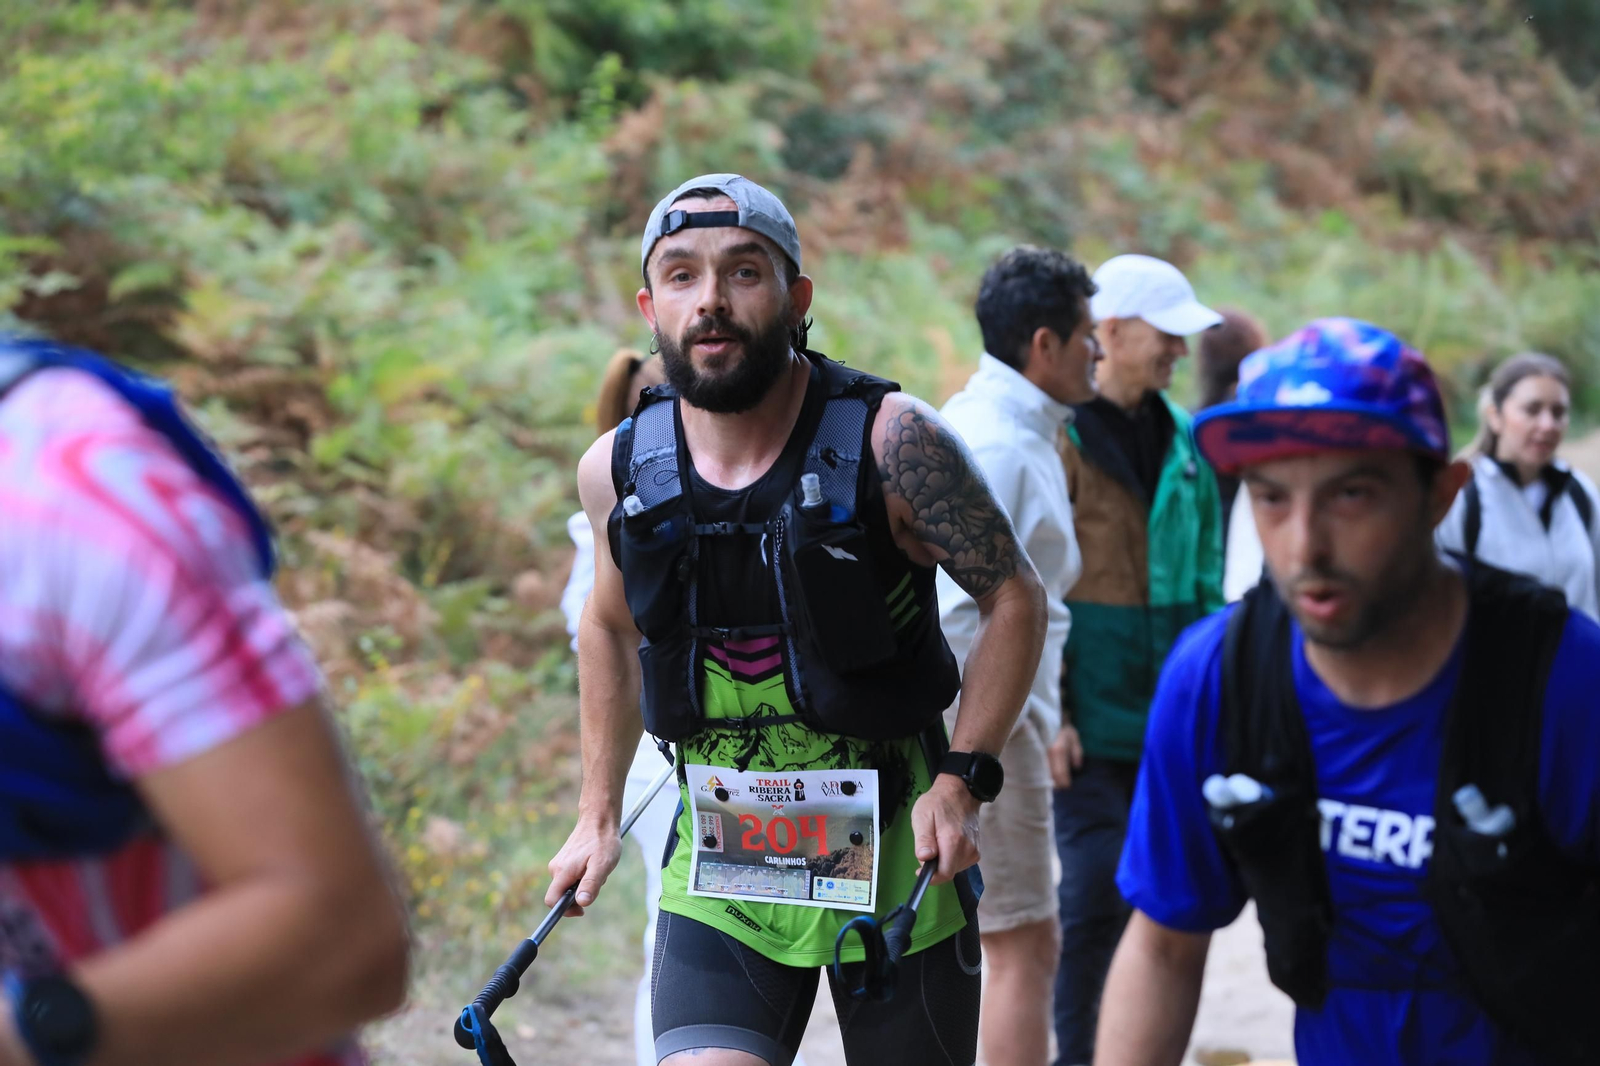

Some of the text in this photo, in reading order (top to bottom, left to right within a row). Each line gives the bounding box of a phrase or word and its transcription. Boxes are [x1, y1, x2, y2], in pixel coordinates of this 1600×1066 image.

[756, 779, 791, 787] TRAIL
[749, 786, 791, 795] RIBEIRA
[757, 795, 792, 803] SACRA
[738, 813, 831, 856] 204
[764, 855, 807, 866] CARLINHOS
